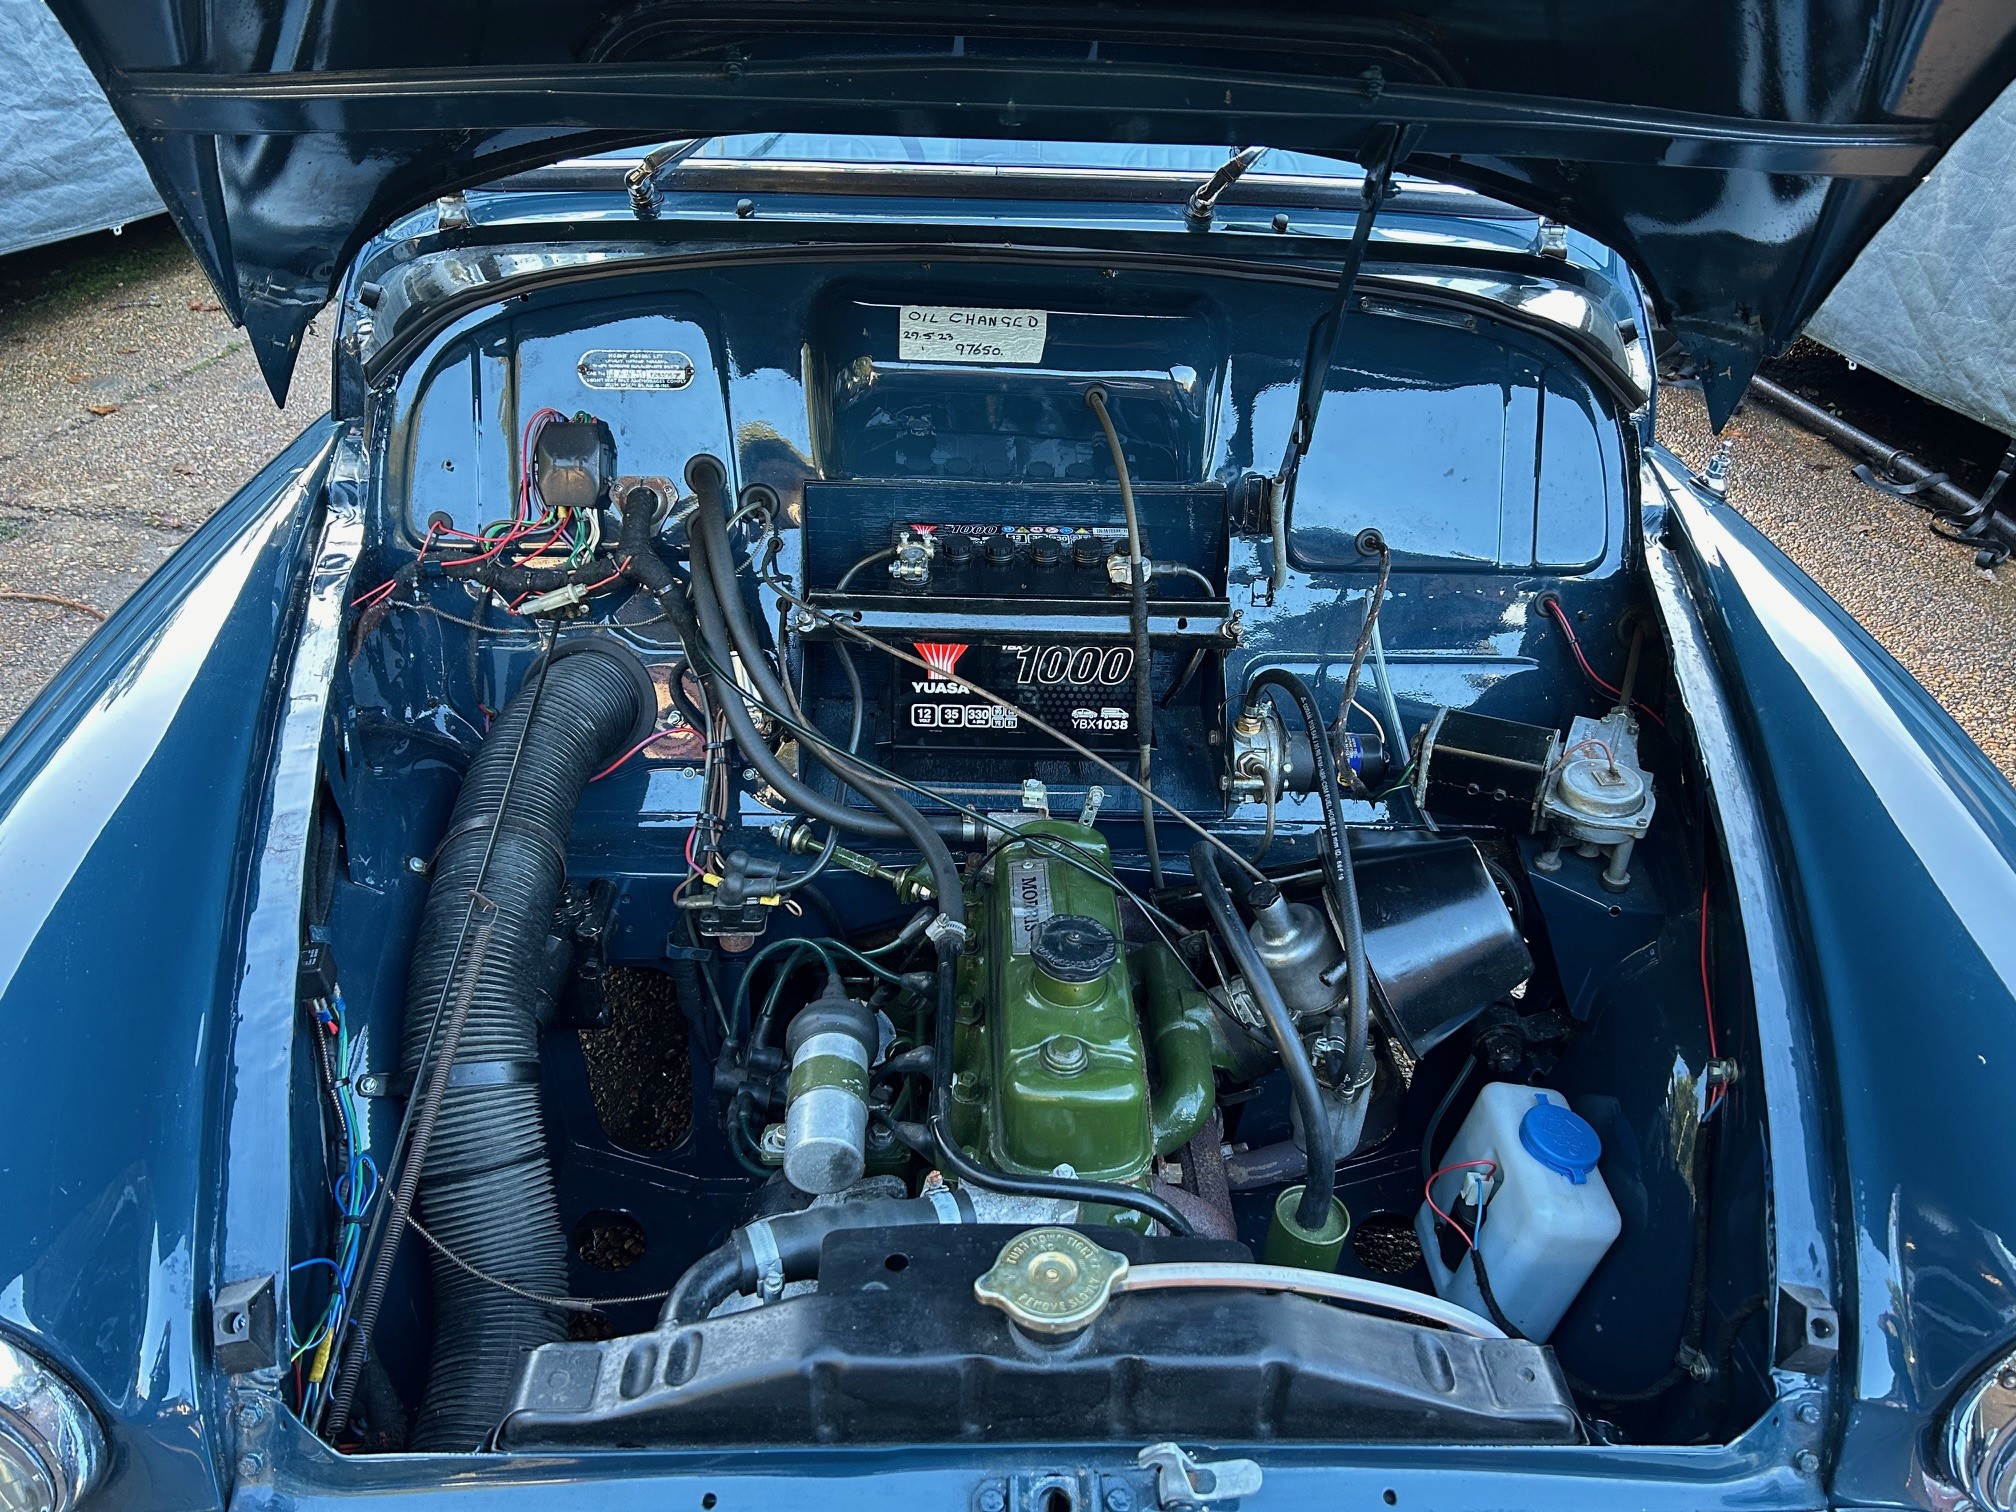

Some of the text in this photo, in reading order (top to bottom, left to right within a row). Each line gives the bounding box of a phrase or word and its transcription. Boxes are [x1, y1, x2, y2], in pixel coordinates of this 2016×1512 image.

[908, 311, 1039, 328] OIL CHANGED
[1016, 645, 1135, 686] 1000
[911, 681, 971, 695] YUASA
[917, 708, 932, 719] 12
[944, 708, 959, 720] 35
[968, 709, 989, 720] 330
[1071, 718, 1129, 730] YBX1038
[1323, 793, 1333, 809] FUEL
[1327, 808, 1337, 827] HOSE
[1006, 1242, 1030, 1265] TURN
[1018, 1293, 1068, 1312] REMOVE
